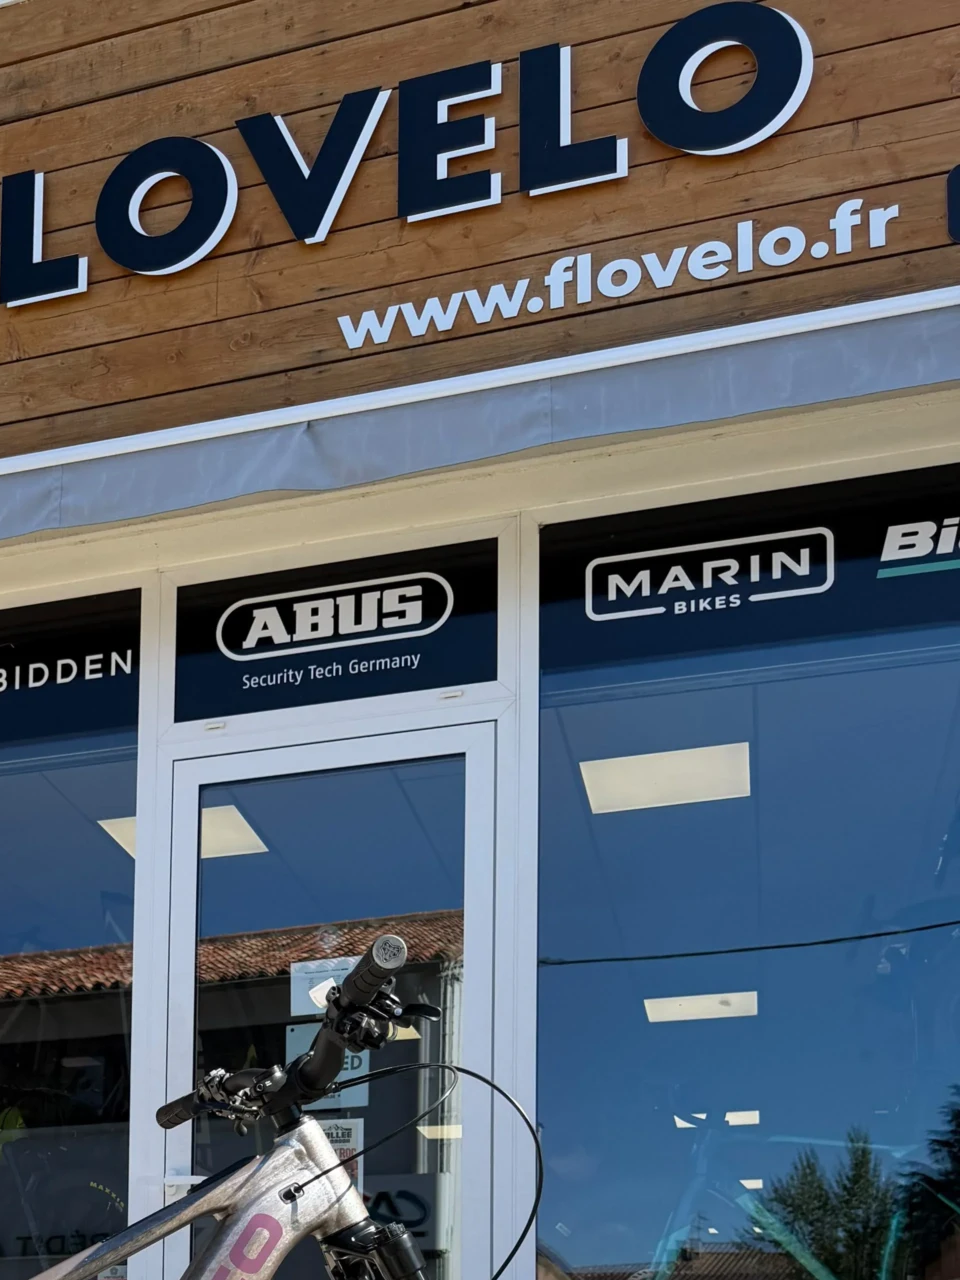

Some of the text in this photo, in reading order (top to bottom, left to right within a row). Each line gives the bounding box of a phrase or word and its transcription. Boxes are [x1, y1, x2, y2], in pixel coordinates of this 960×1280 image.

[337, 197, 900, 350] www.flovelo.fr
[880, 516, 960, 562] Bi
[607, 548, 810, 602] MARIN
[241, 585, 423, 649] ABUS
[674, 593, 741, 615] BIKES
[241, 654, 421, 690] Security Tech Germany
